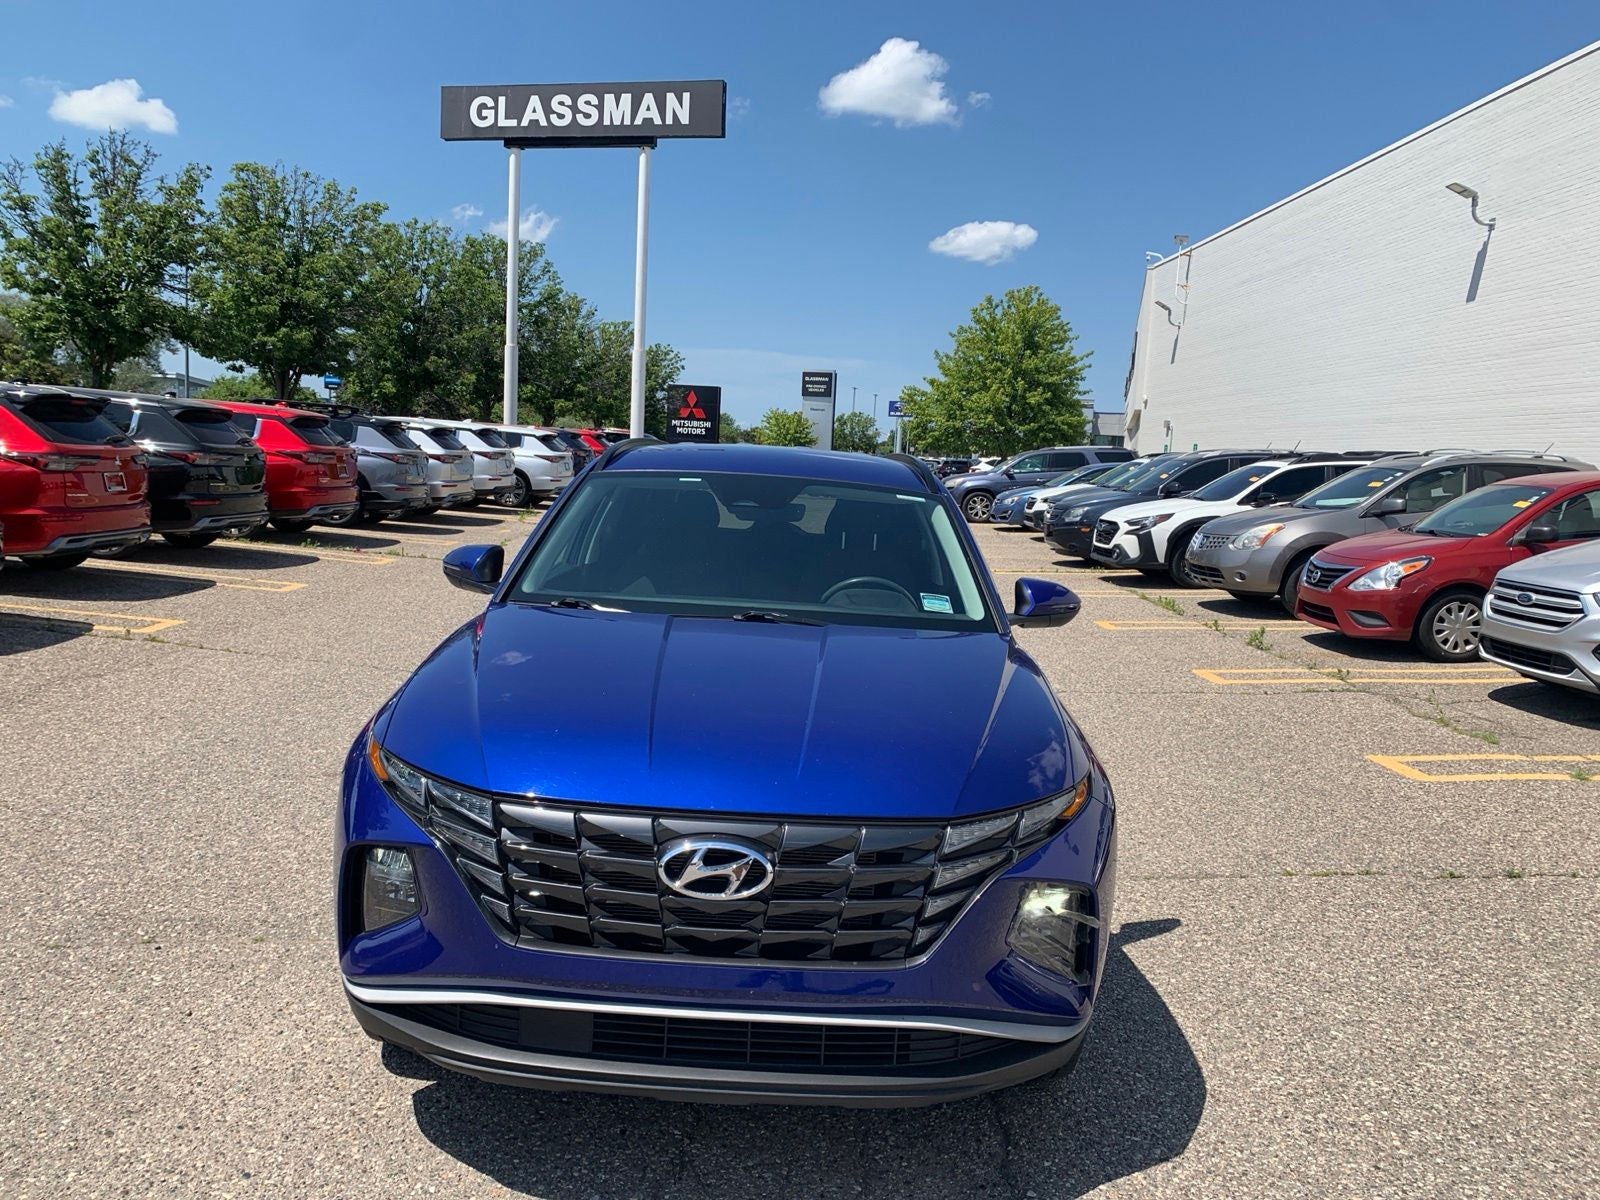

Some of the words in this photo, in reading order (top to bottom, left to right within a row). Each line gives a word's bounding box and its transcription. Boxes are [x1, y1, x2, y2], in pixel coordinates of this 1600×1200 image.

[469, 92, 691, 127] GLASSMAN
[671, 420, 712, 428] MITSUBISHI
[676, 427, 706, 435] MOTORS
